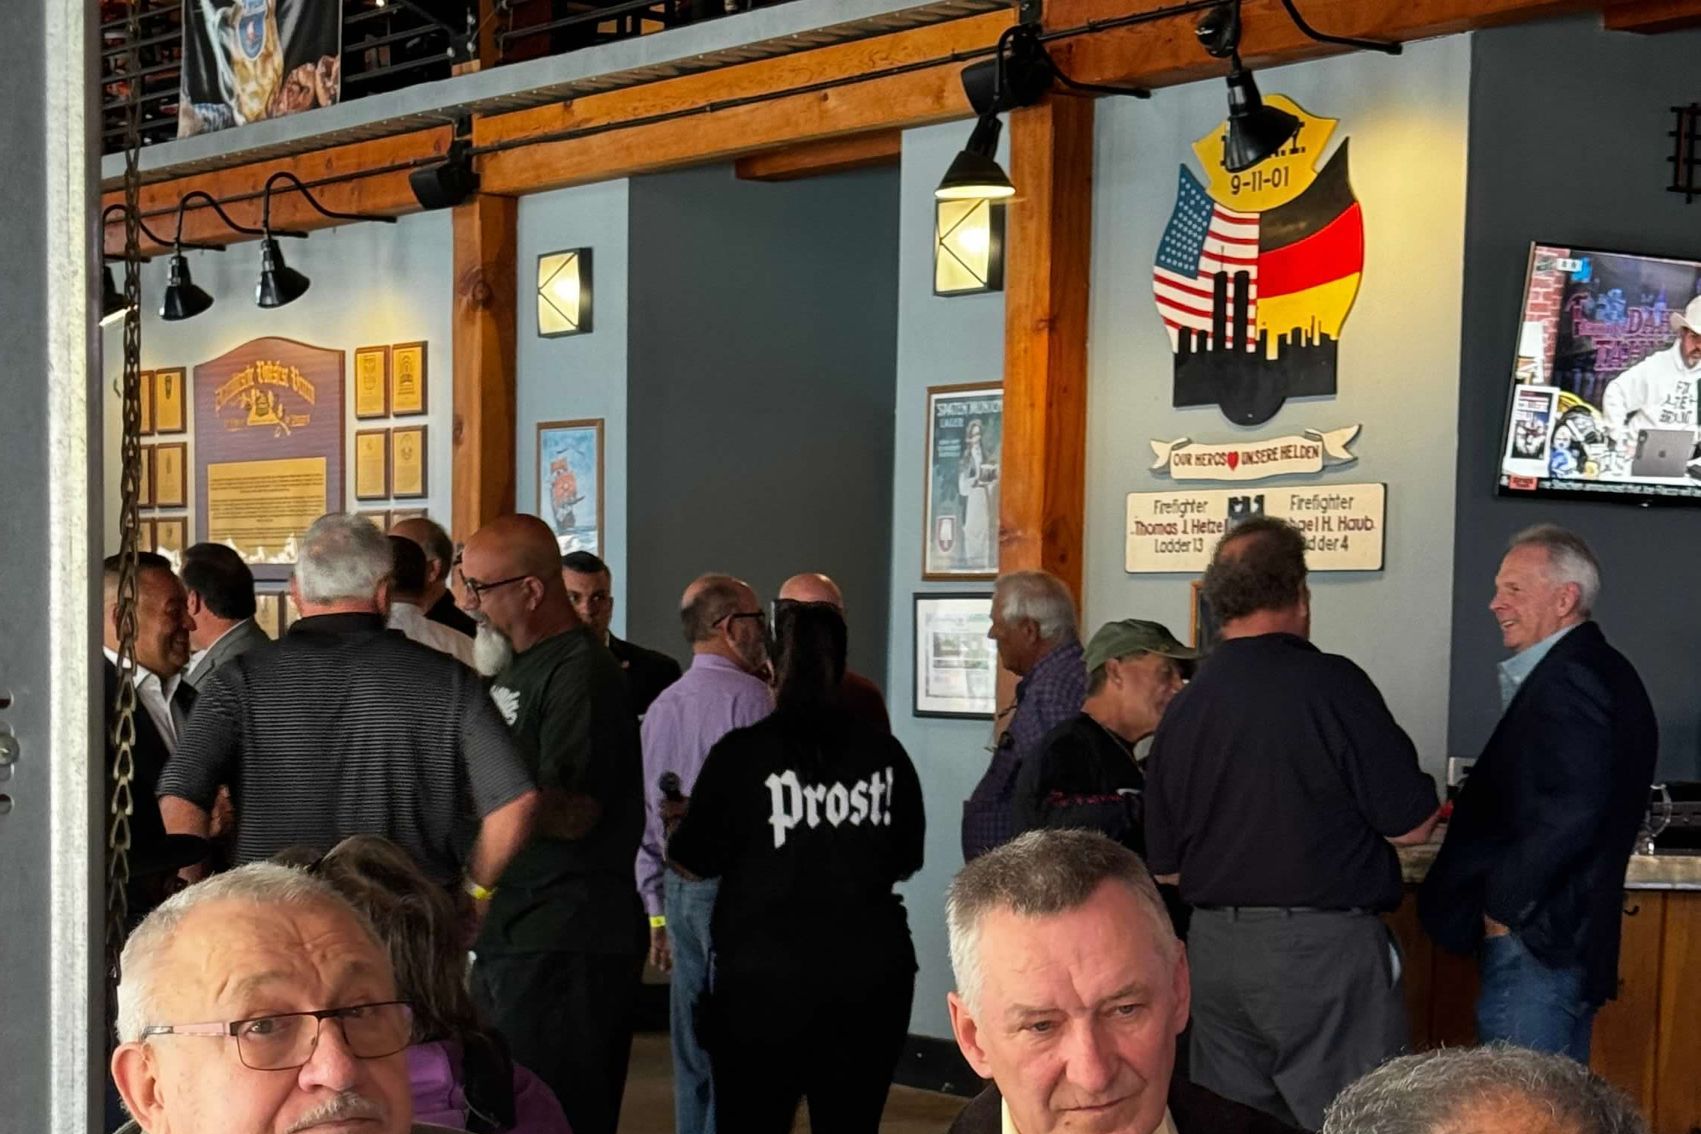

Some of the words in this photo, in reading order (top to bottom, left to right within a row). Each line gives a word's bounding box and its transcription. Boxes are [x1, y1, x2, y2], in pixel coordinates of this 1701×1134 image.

[1231, 166, 1289, 195] 9-11-01
[1173, 453, 1192, 467] OUR
[1195, 452, 1227, 467] HEROS
[1241, 447, 1279, 464] UNSERE
[1280, 444, 1320, 460] HELDEN
[1153, 499, 1208, 518] Firefighter
[1290, 494, 1354, 514] Firefighter
[1134, 520, 1178, 536] Thomas
[1338, 515, 1375, 532] Haub
[1154, 538, 1191, 553] Ladder
[1193, 537, 1204, 553] 13
[1340, 535, 1349, 552] 4
[765, 767, 893, 849] Prost!
